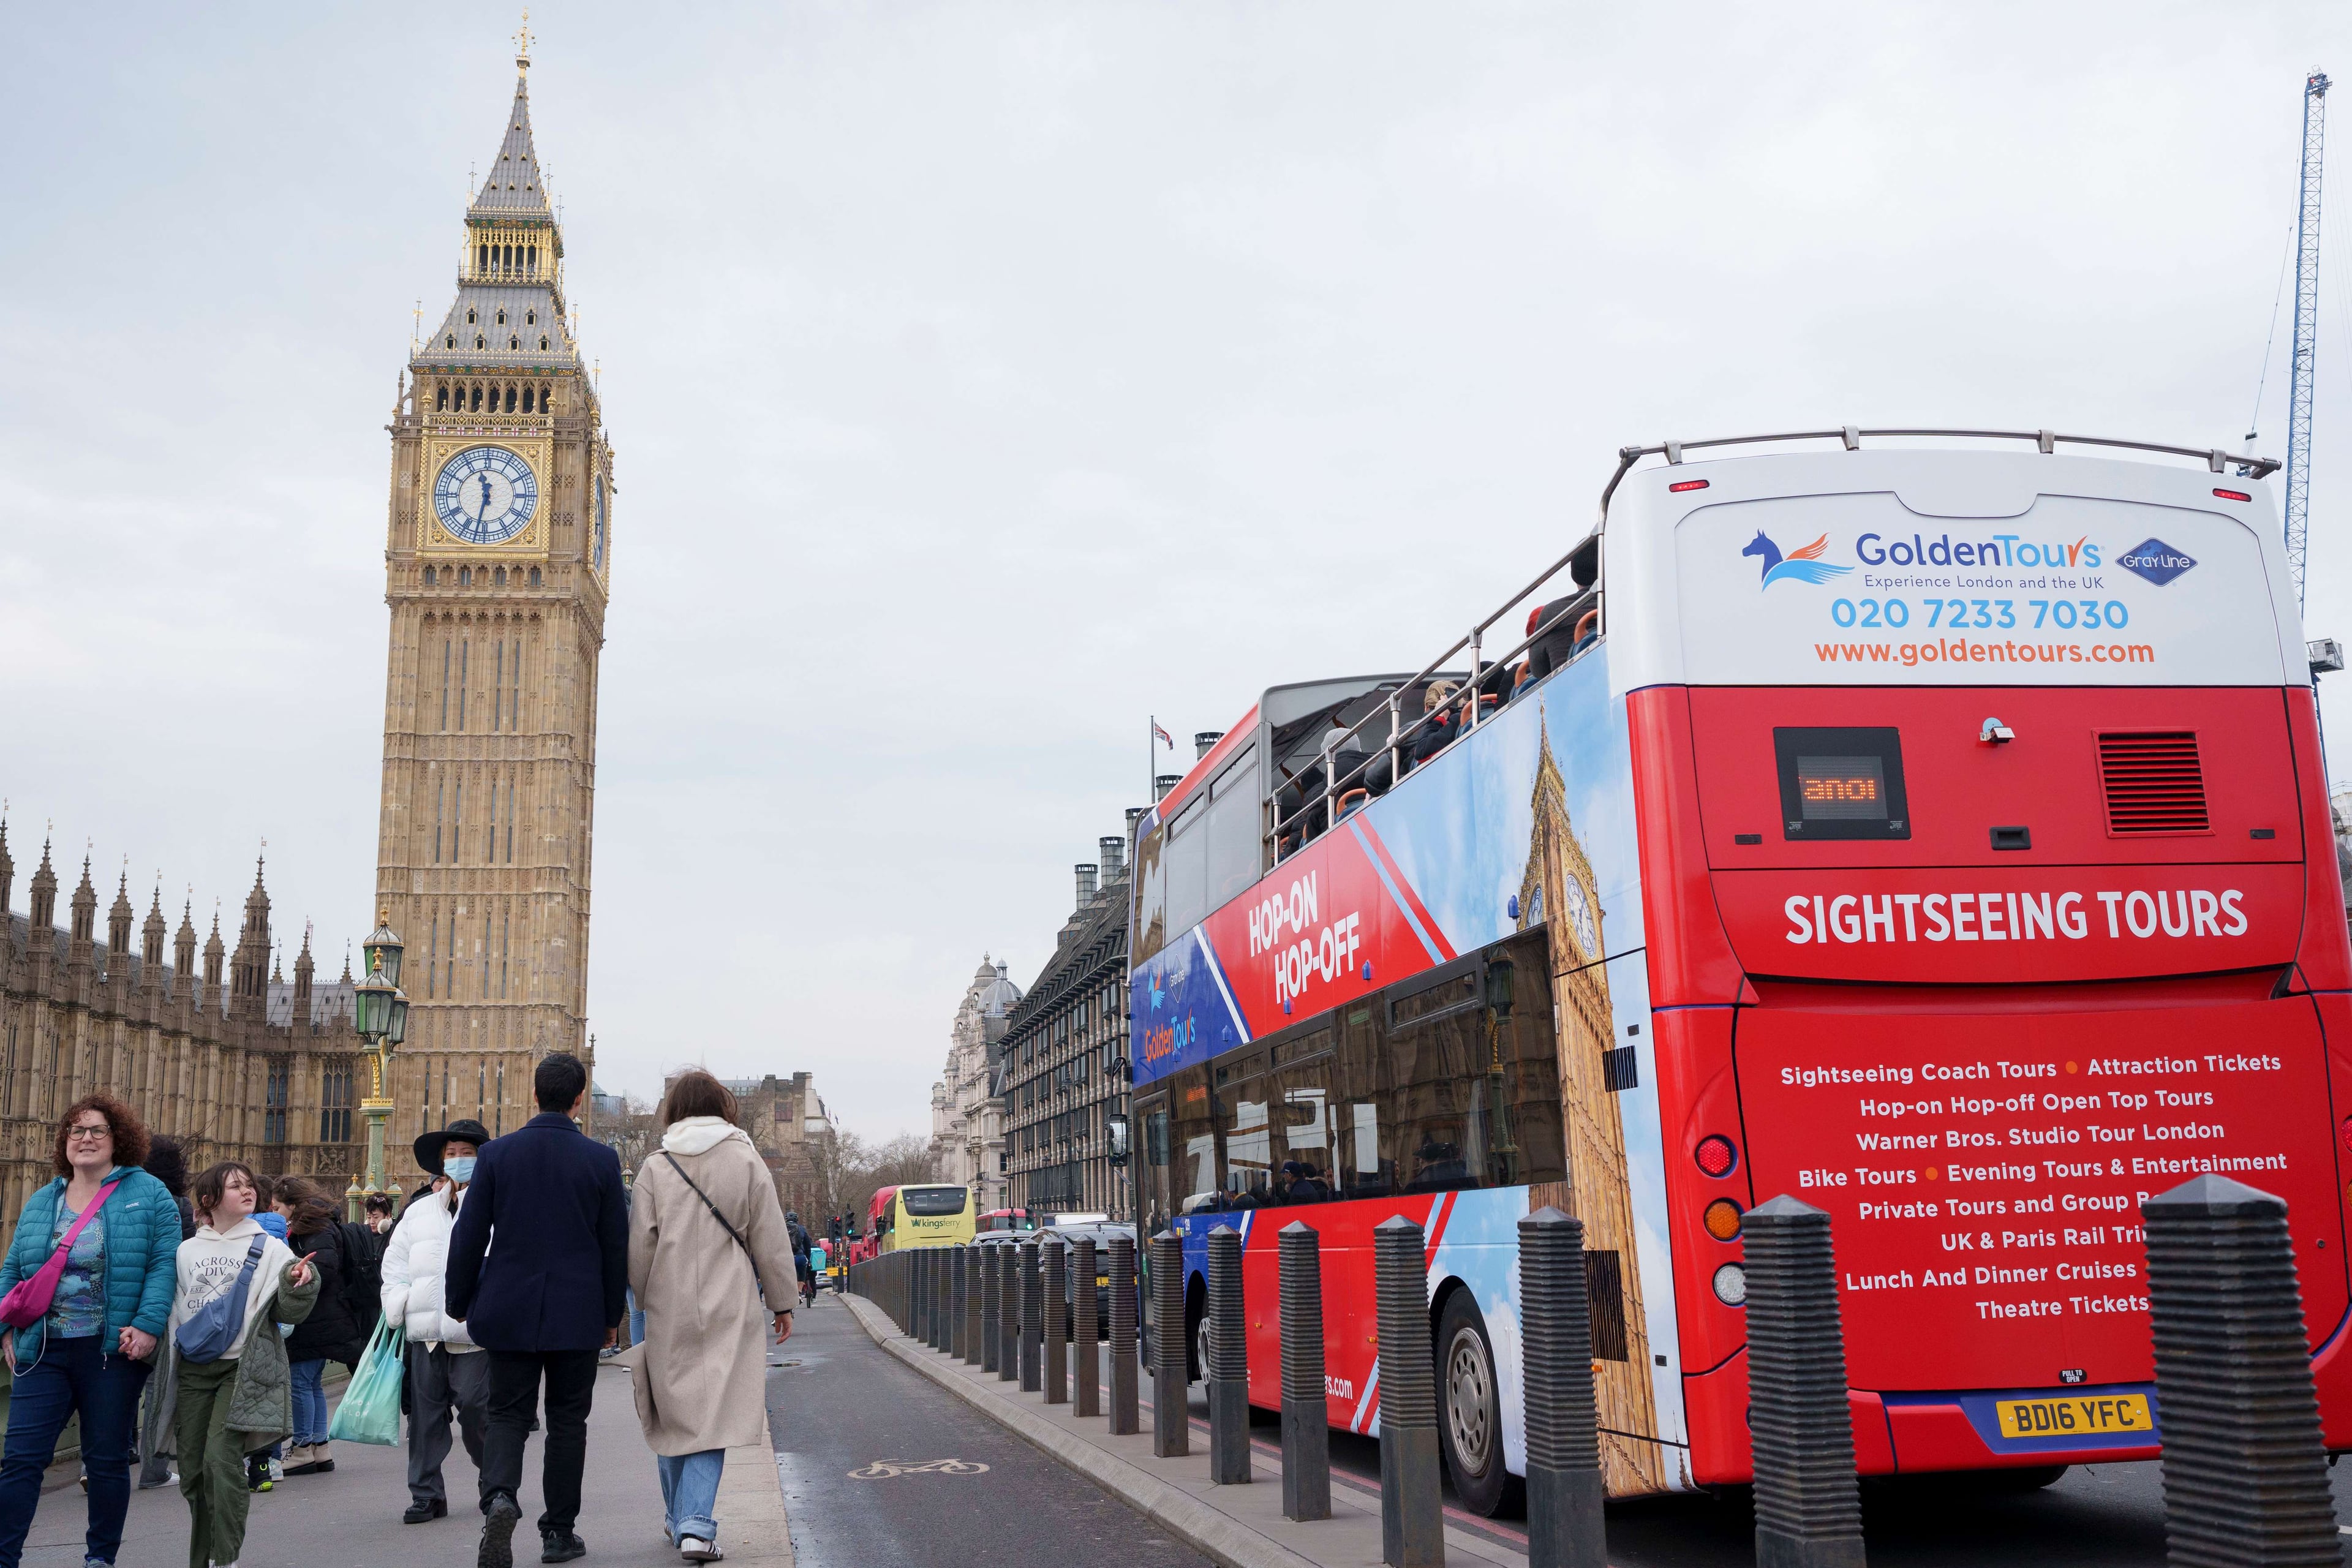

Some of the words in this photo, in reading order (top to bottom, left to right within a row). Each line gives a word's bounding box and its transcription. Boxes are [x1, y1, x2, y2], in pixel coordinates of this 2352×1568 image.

[1856, 533, 2101, 568] GoldenTours
[1864, 575, 1950, 591] Experience
[1957, 575, 2013, 588] London
[2019, 576, 2046, 589] and
[2052, 576, 2076, 589] the
[2082, 577, 2104, 589] UK
[1831, 598, 1909, 628] 020
[1923, 598, 2016, 629] 7233
[2029, 600, 2129, 630] 7030
[1814, 638, 2155, 666] www.goldentours.com
[1249, 870, 1318, 957] HOP-ON
[1785, 891, 2087, 944] SIGHTSEEING
[2097, 889, 2248, 940] TOURS
[1275, 911, 1359, 1005] HOP-OFF
[1145, 1007, 1196, 1063] GoldenTours
[1782, 1065, 1913, 1087] Sightseeing
[1922, 1062, 1989, 1080] Coach
[1997, 1062, 2056, 1078] Tours
[2088, 1057, 2197, 1076] Attraction
[2204, 1055, 2281, 1072] Tickets
[1861, 1099, 1942, 1118] Hop-on
[1951, 1094, 2035, 1115] Hop-off
[2043, 1094, 2100, 1112] Open
[2108, 1092, 2147, 1110] Top
[2155, 1090, 2213, 1106] Tours
[1856, 1133, 1937, 1151] Warner
[1947, 1131, 2001, 1147] Bros.
[2009, 1126, 2079, 1145] Studio
[2087, 1126, 2135, 1142] Tour
[2144, 1122, 2224, 1140] London
[1800, 1169, 1847, 1187] Bike
[1855, 1169, 1916, 1185] Tours
[1948, 1163, 2035, 1182] Evening
[2043, 1161, 2102, 1178] Tours
[2111, 1159, 2124, 1175] &
[2132, 1153, 2287, 1174] Entertainment
[1860, 1201, 1937, 1219] Private
[1945, 1199, 2006, 1215] Tours
[2015, 1195, 2054, 1213] and
[2062, 1194, 2128, 1212] Group
[922, 1218, 961, 1229] kingsferry
[1942, 1232, 1973, 1251] UK
[1980, 1231, 1994, 1249] &
[2002, 1229, 2056, 1248] Paris
[2064, 1226, 2105, 1245] Rail
[205, 1267, 227, 1276] DIV.
[1847, 1270, 1913, 1291] Lunch
[1923, 1268, 1966, 1286] And
[1975, 1265, 2048, 1284] Dinner
[2057, 1261, 2136, 1280] Cruises
[1976, 1300, 2062, 1319] Theatre
[2070, 1295, 2149, 1314] Tickets
[2014, 1403, 2076, 1432] BD16
[2080, 1400, 2135, 1428] YFC
